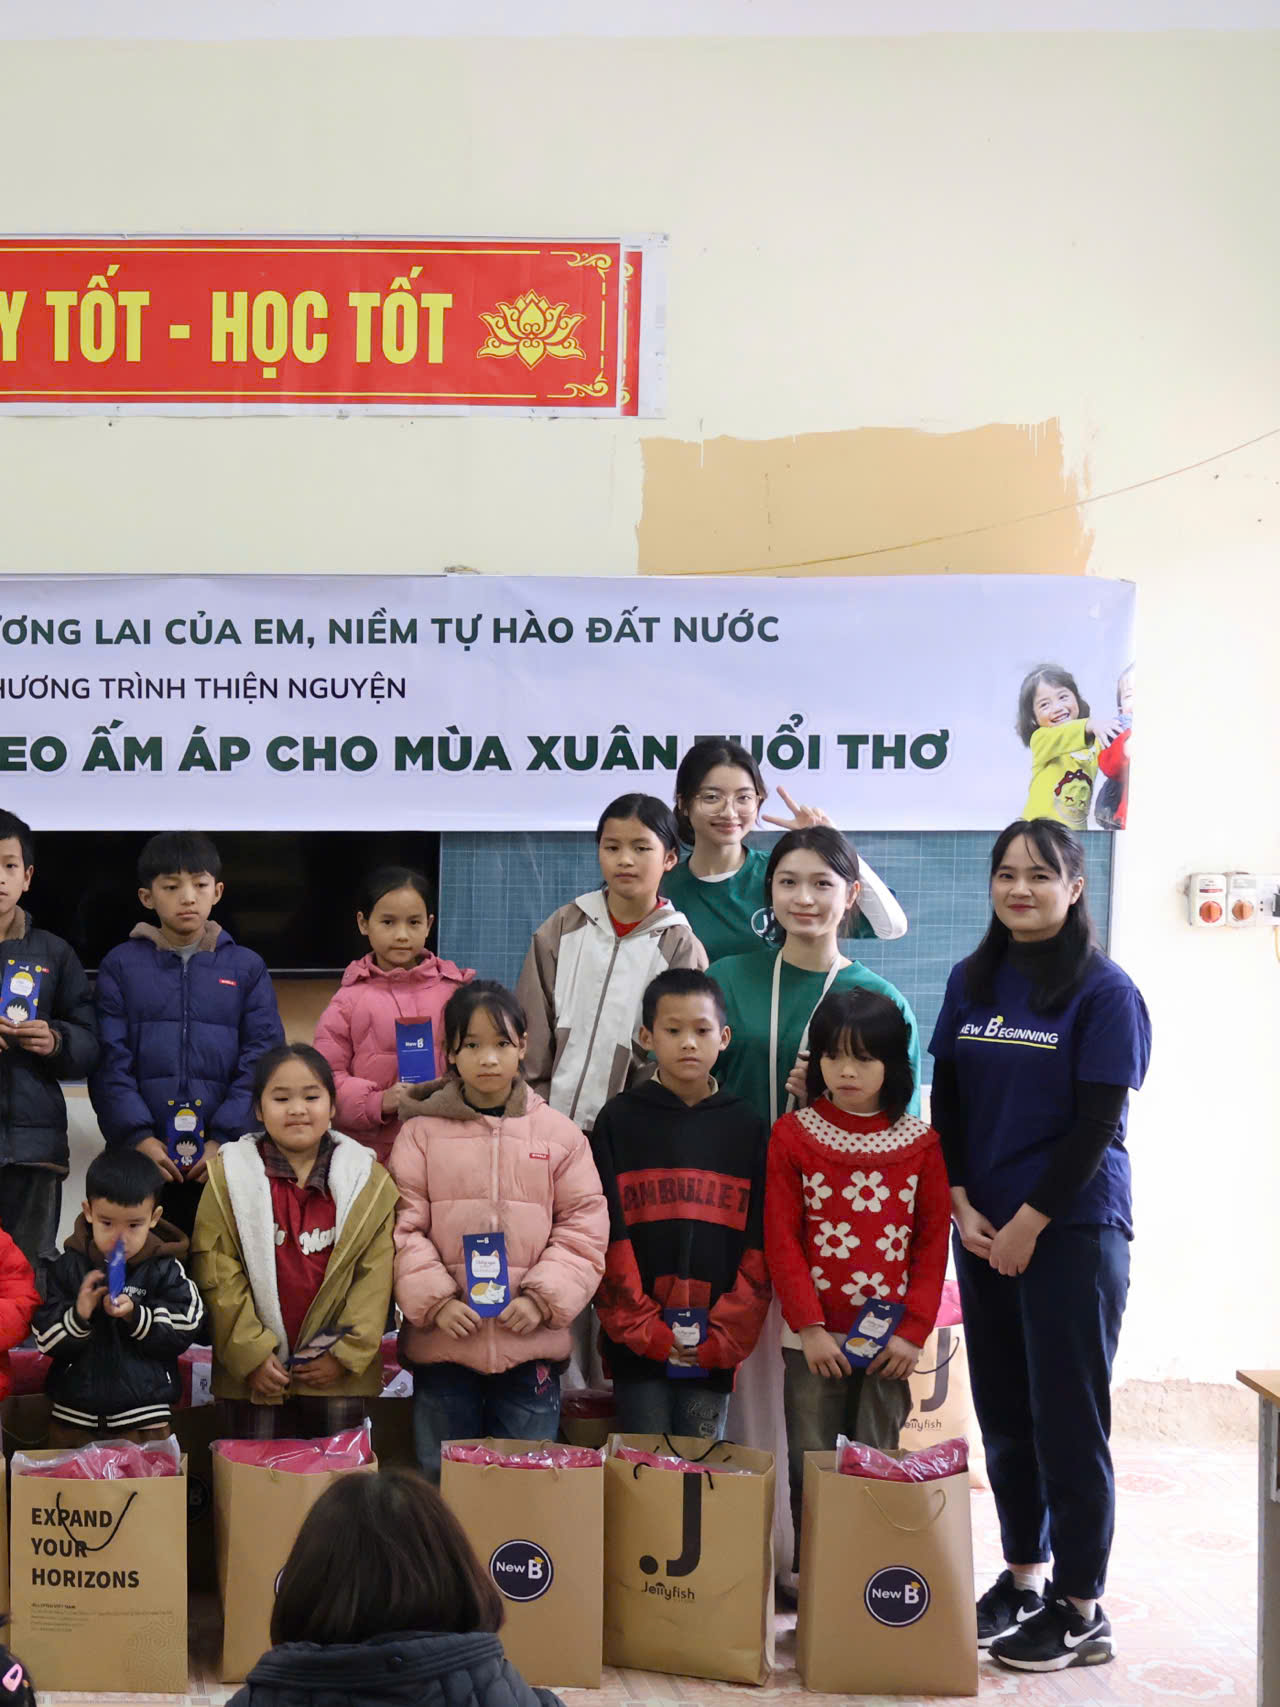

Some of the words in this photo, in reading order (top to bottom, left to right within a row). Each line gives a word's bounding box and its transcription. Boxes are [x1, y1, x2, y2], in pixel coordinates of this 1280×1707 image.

[45, 264, 150, 363] TỐT
[211, 290, 329, 379] HỌC
[348, 266, 453, 365] TỐT
[95, 619, 151, 645] LAI
[165, 610, 242, 645] CỦA
[254, 618, 315, 649] EM,
[328, 607, 418, 645] NIỀM
[430, 613, 483, 652] TỰ
[493, 609, 574, 644] HÀO
[585, 605, 661, 643] ĐẤT
[674, 608, 779, 643] NƯỚC
[98, 671, 185, 699] TRÌNH
[194, 671, 278, 705] THIỆN
[288, 671, 406, 705] NGUYỆN
[81, 719, 163, 772] ẤM
[177, 724, 251, 772] ÁP
[265, 735, 378, 772] CHO
[394, 725, 513, 772] MÙA
[526, 724, 678, 772] XUÂN
[837, 728, 950, 770] THƠ
[984, 1017, 1059, 1044] BEGINNING
[31, 1507, 113, 1528] EXPAND
[31, 1537, 88, 1558] YOUR
[31, 1567, 140, 1589] HORIZONS
[495, 1561, 525, 1573] New
[528, 1558, 543, 1579] B
[871, 1588, 902, 1599] New
[904, 1584, 920, 1604] B
